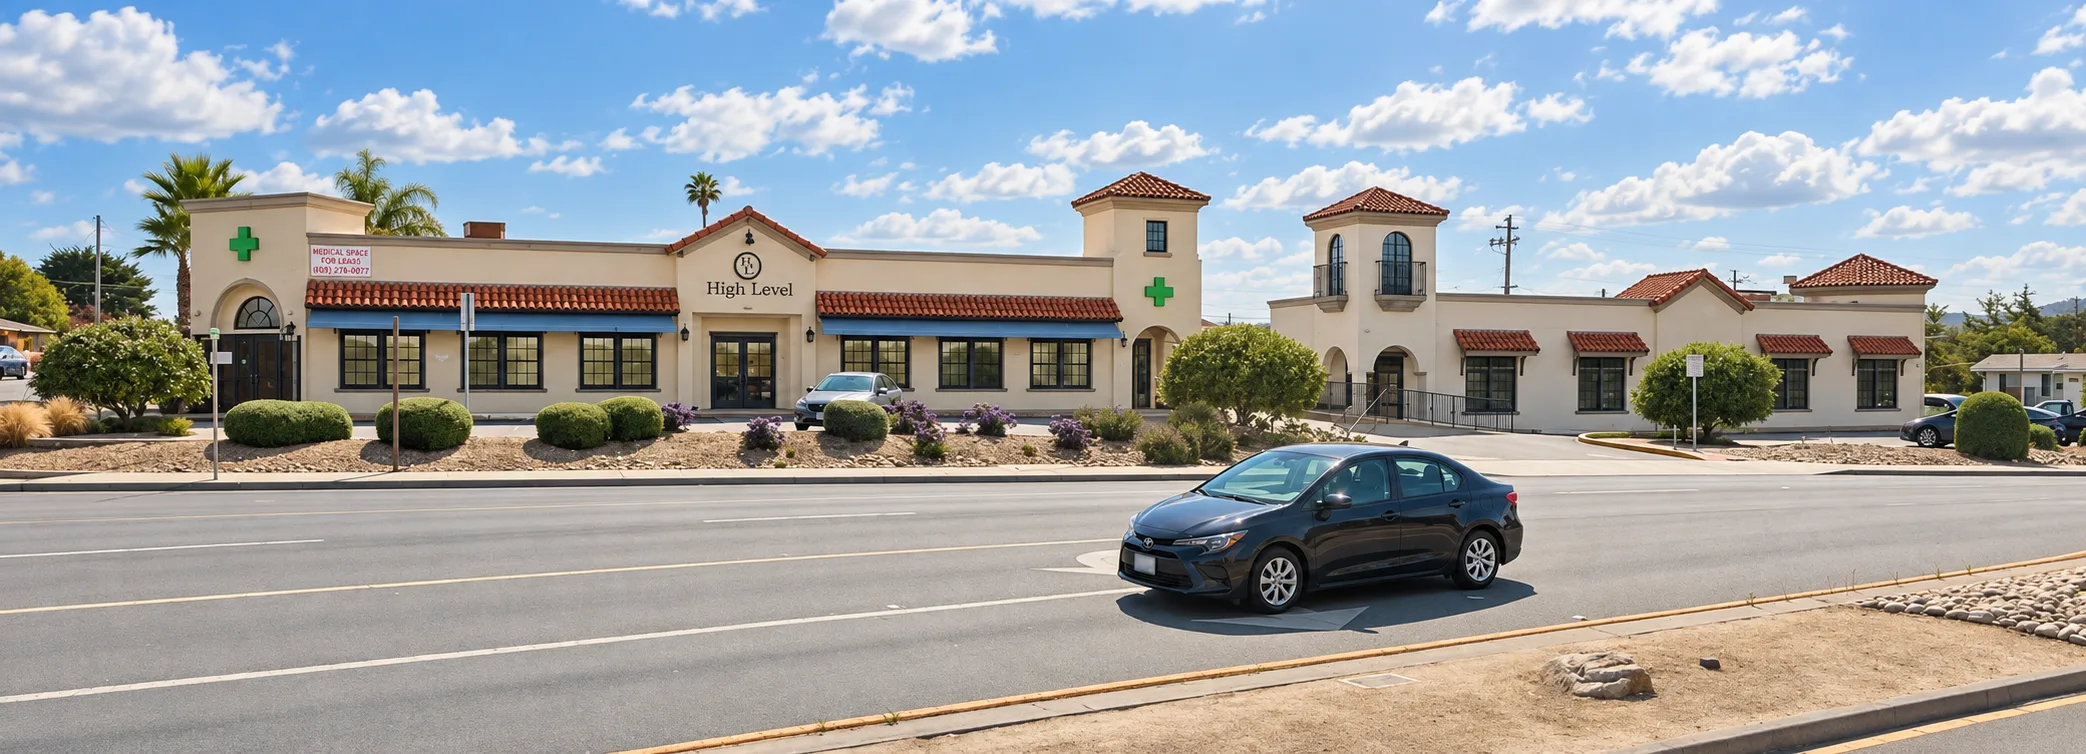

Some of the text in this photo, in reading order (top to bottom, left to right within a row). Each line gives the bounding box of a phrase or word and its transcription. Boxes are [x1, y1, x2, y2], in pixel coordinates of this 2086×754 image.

[312, 248, 369, 257] MEDICAL SPACE
[706, 281, 793, 299] High Level
